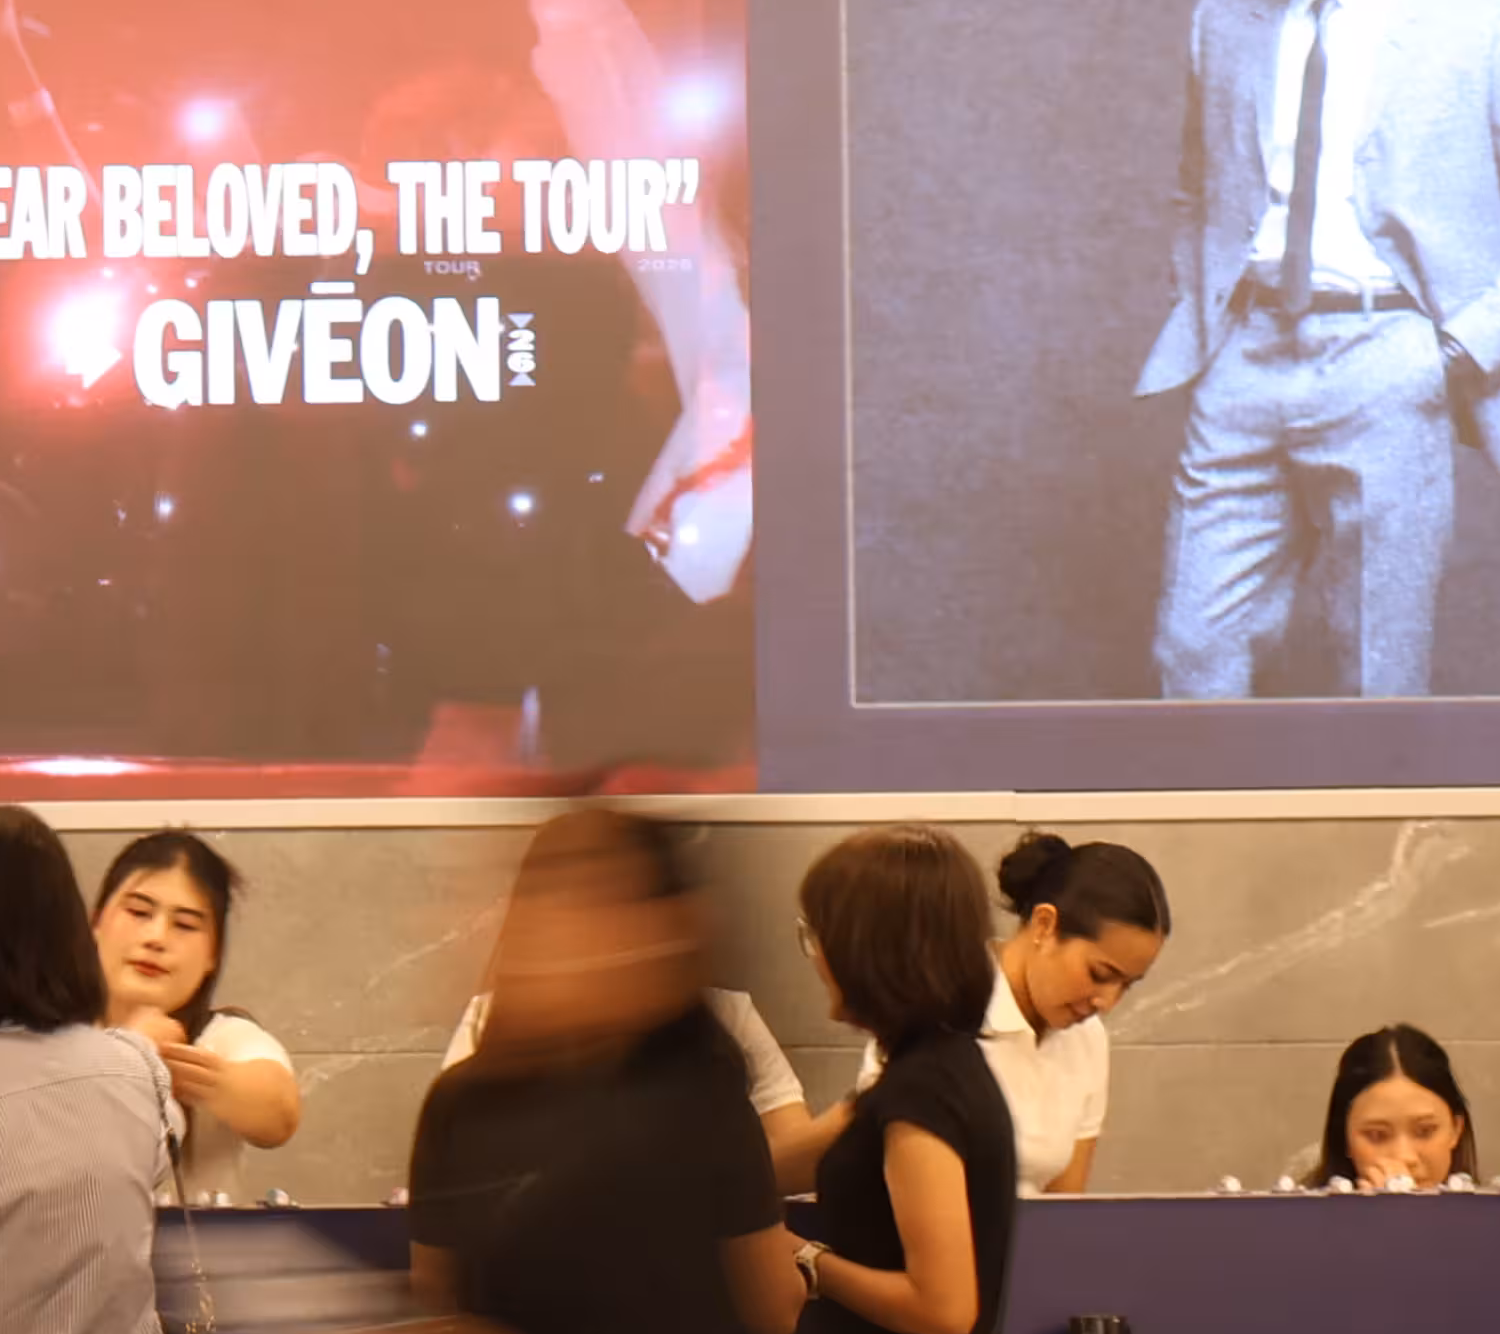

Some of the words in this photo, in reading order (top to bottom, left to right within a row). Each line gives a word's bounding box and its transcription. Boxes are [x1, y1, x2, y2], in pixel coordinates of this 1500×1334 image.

[103, 163, 374, 276] BELOVED,
[387, 160, 501, 255] THE
[512, 157, 700, 255] TOUR”
[424, 261, 480, 276] TOUR
[133, 281, 501, 410] GIVĒON
